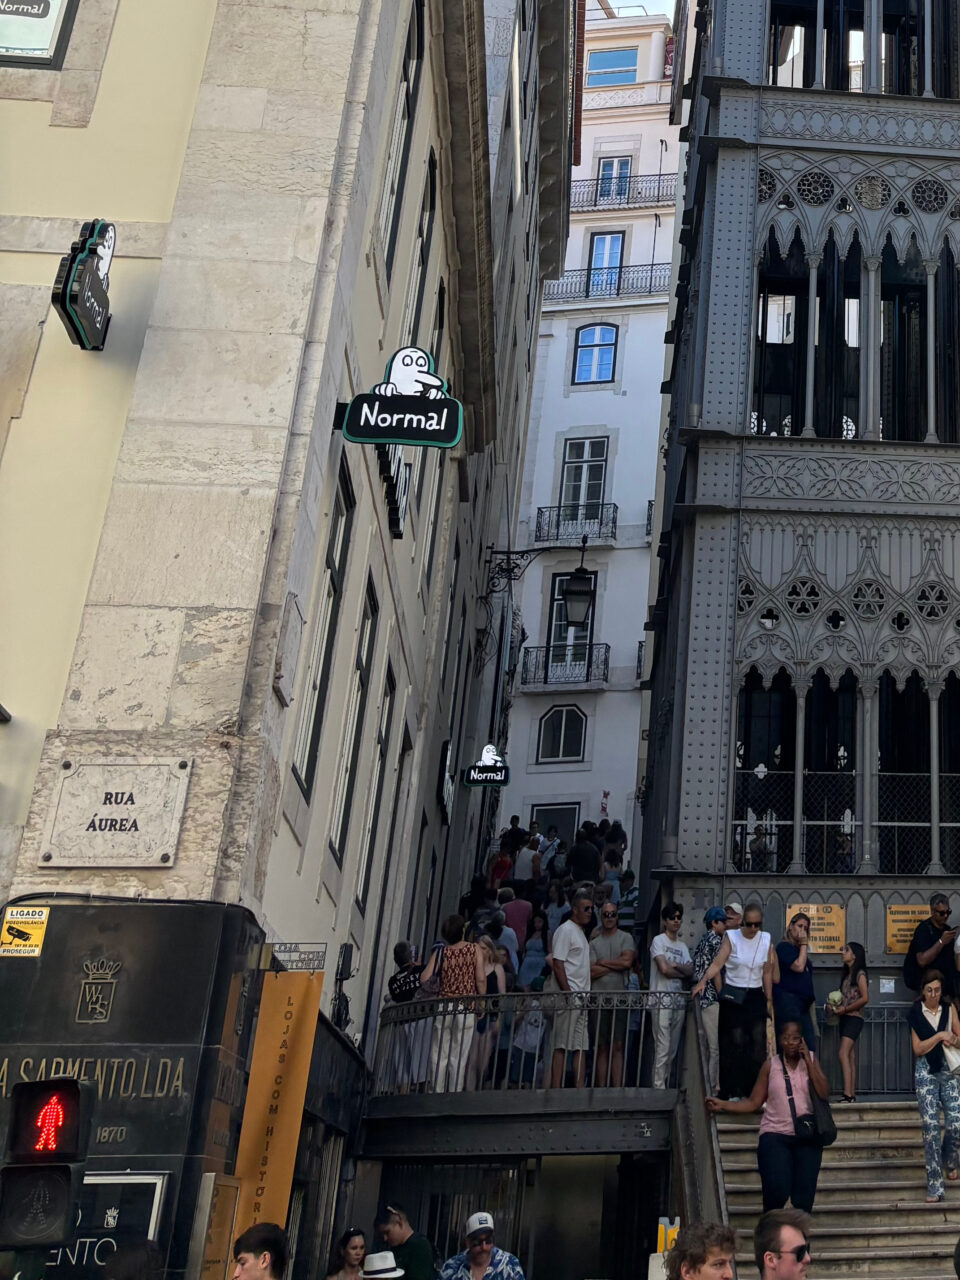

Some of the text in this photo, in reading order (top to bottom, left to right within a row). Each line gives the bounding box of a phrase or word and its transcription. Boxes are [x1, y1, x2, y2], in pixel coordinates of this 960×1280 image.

[0, 0, 44, 14] Normal
[360, 401, 448, 430] Normal
[470, 768, 505, 780] Normal
[103, 791, 136, 805] RUA
[85, 812, 139, 832] ÁUREA
[96, 1126, 127, 1143] 1870
[253, 1126, 274, 1225] HISTÓRI
